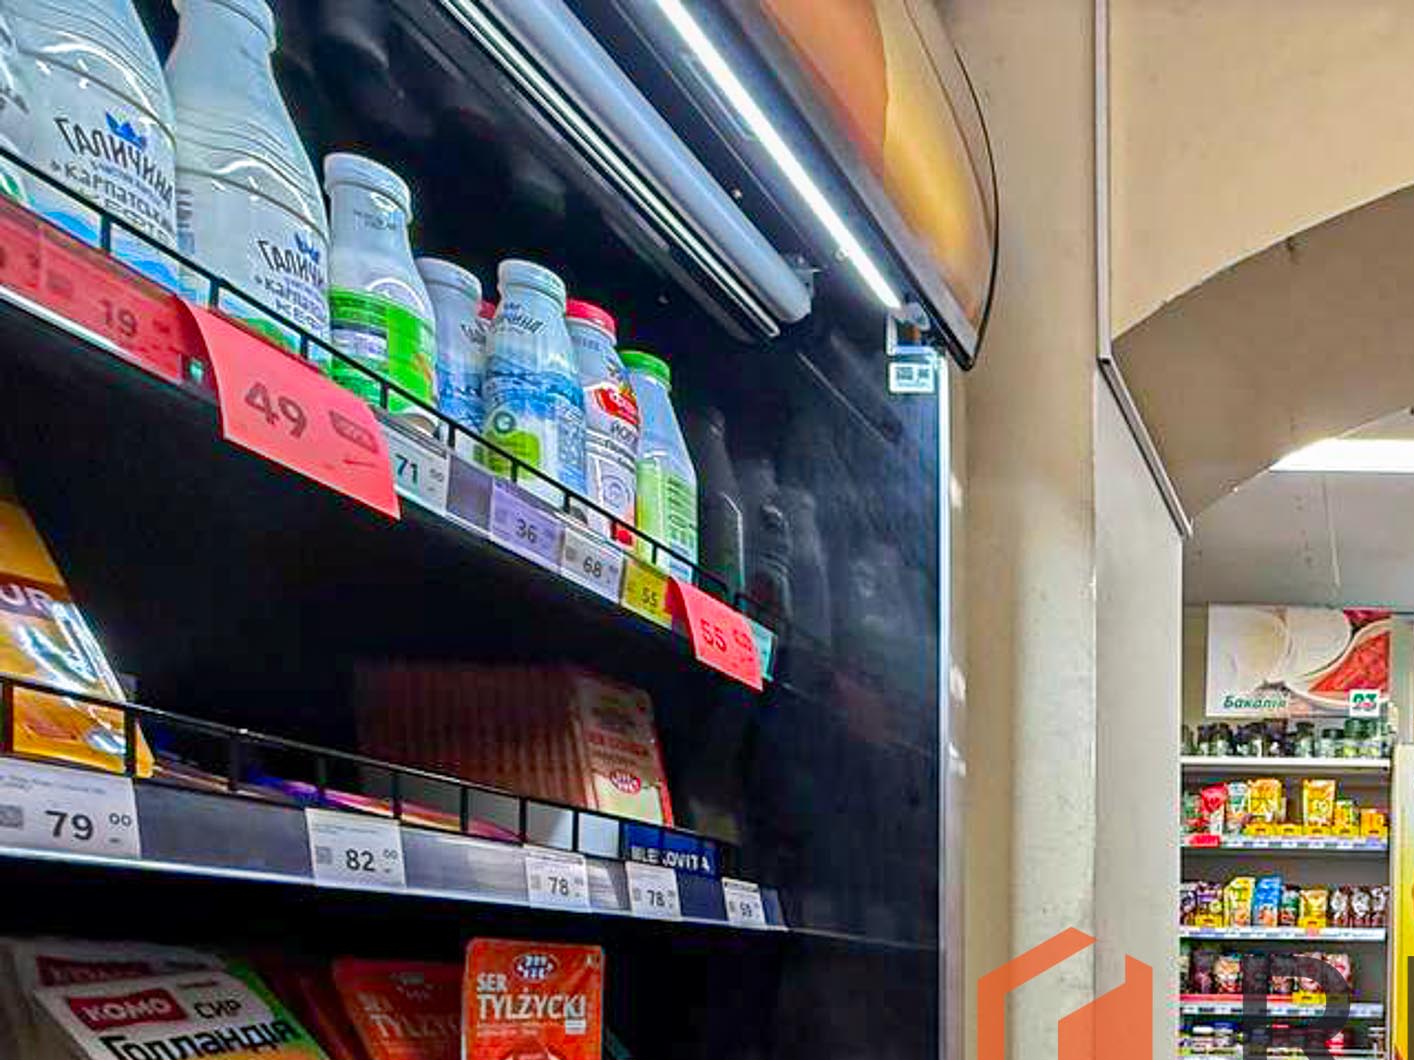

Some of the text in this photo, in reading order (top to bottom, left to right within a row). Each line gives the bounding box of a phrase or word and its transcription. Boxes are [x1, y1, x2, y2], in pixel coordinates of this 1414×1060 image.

[244, 381, 308, 439] 49
[45, 810, 95, 841] 79
[345, 849, 375, 872] 82
[549, 875, 569, 896] 78
[476, 972, 508, 993] SER
